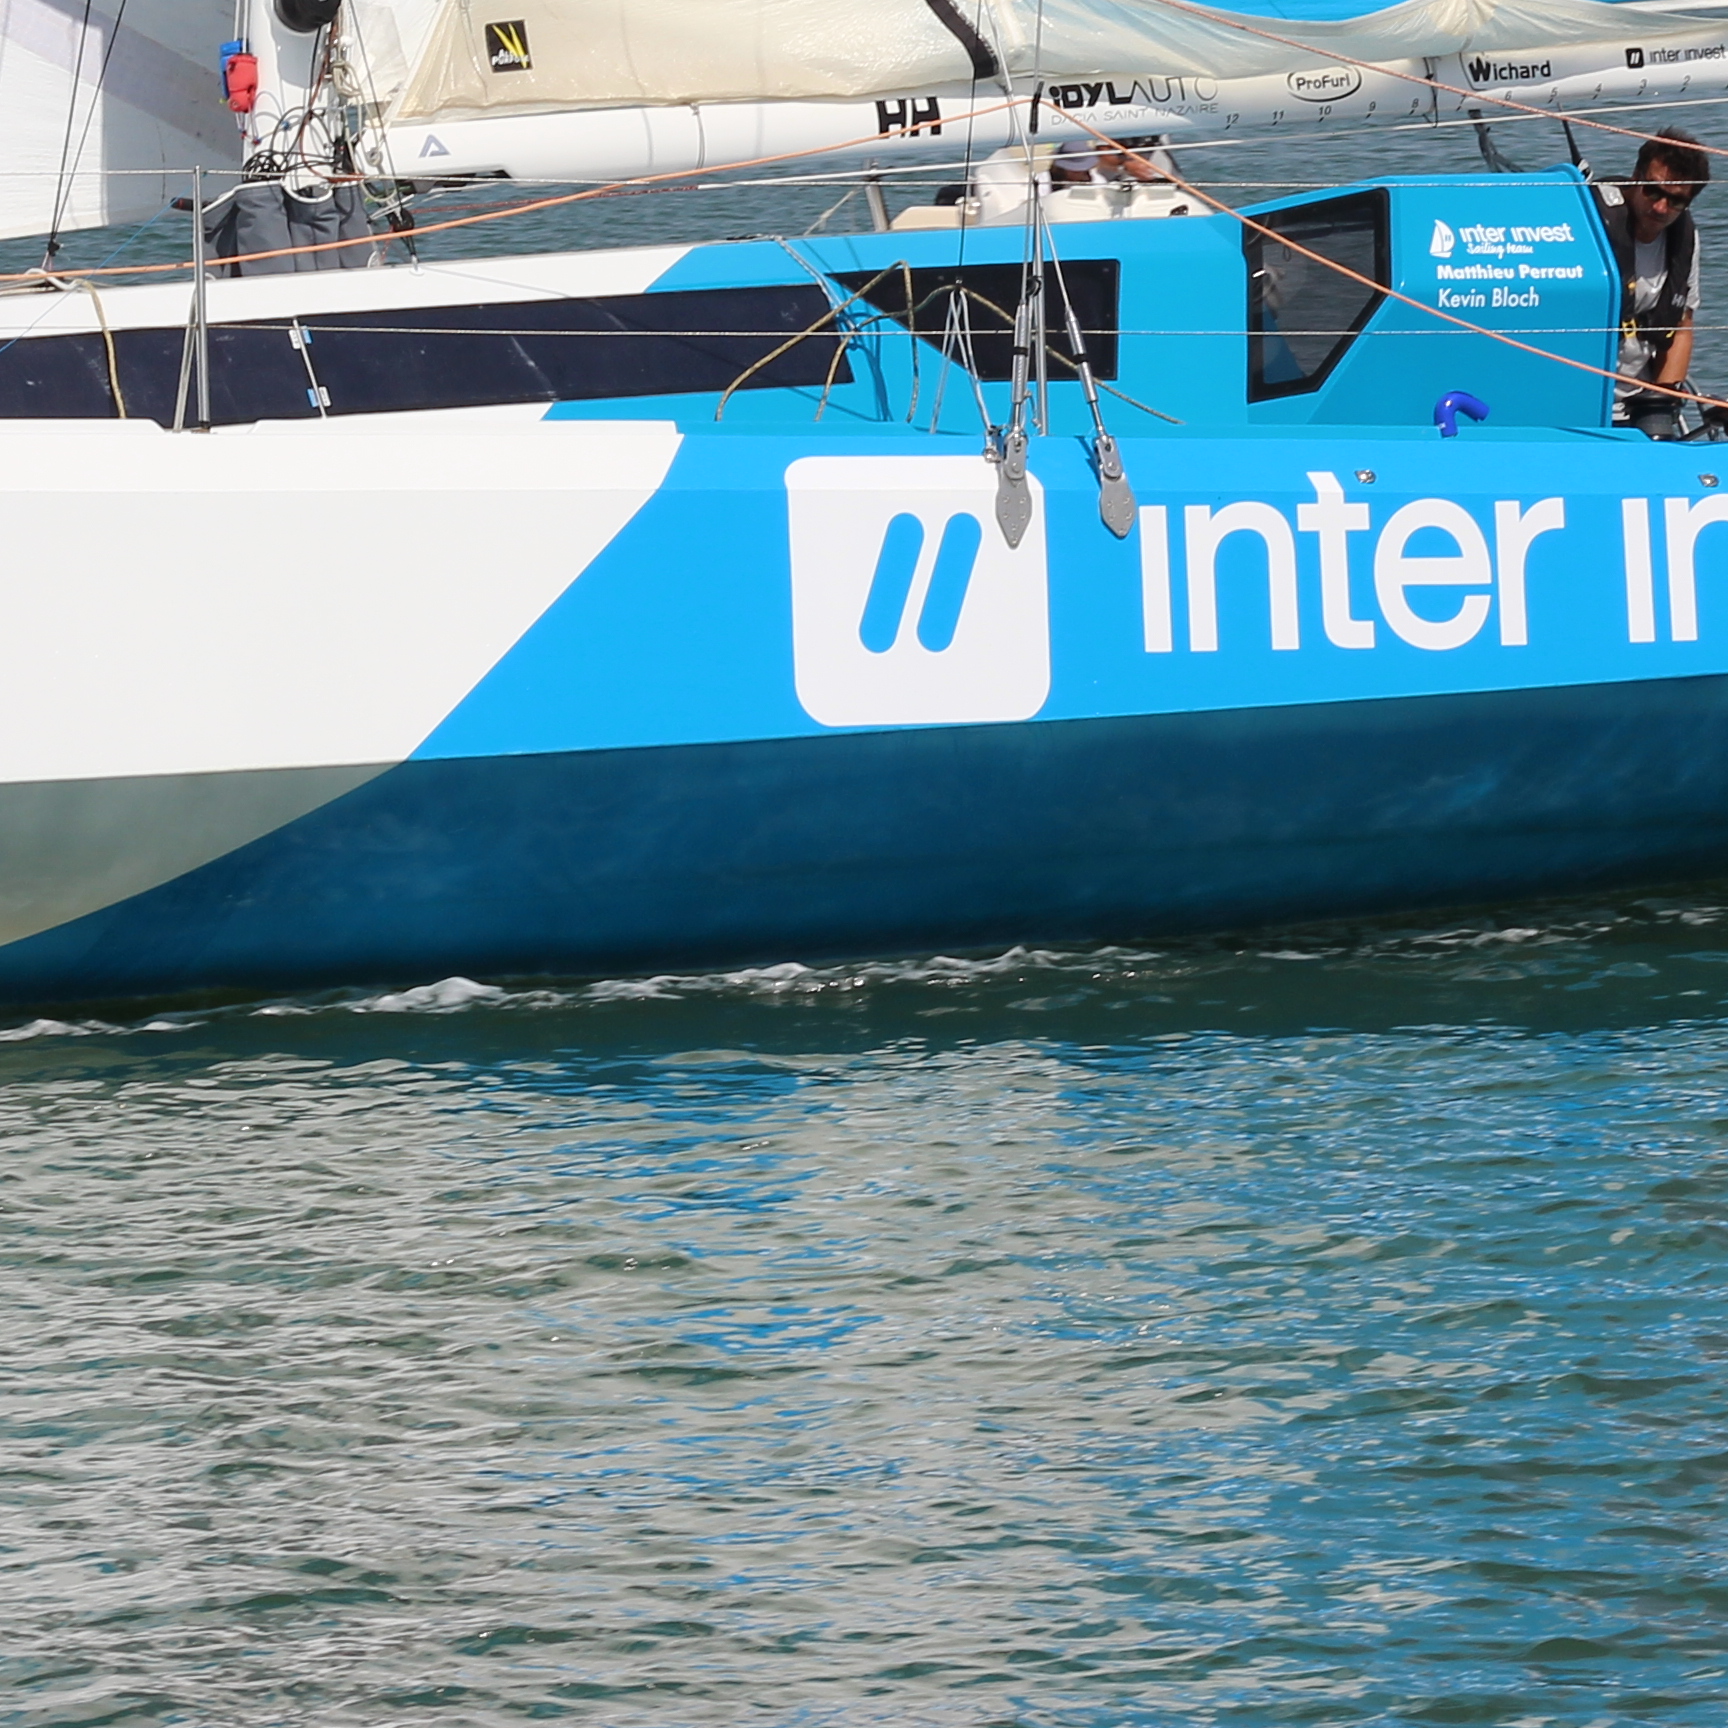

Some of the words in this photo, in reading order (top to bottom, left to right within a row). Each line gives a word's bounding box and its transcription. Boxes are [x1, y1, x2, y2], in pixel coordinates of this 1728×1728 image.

[1650, 47, 1681, 63] inter
[1684, 44, 1727, 60] invest
[1468, 54, 1552, 83] Wichard
[1295, 73, 1351, 91] ProFurl
[1103, 108, 1149, 122] SAINT
[1155, 103, 1219, 117] NAZAIRE
[1318, 105, 1332, 116] 10
[1459, 224, 1507, 242] inter
[1510, 222, 1575, 241] invest
[1506, 242, 1534, 254] team
[1436, 264, 1515, 280] Matthieu
[1518, 263, 1584, 279] Perraut
[1438, 287, 1486, 308] Kevin
[1491, 286, 1540, 308] Bloch
[1138, 472, 1566, 653] inter
